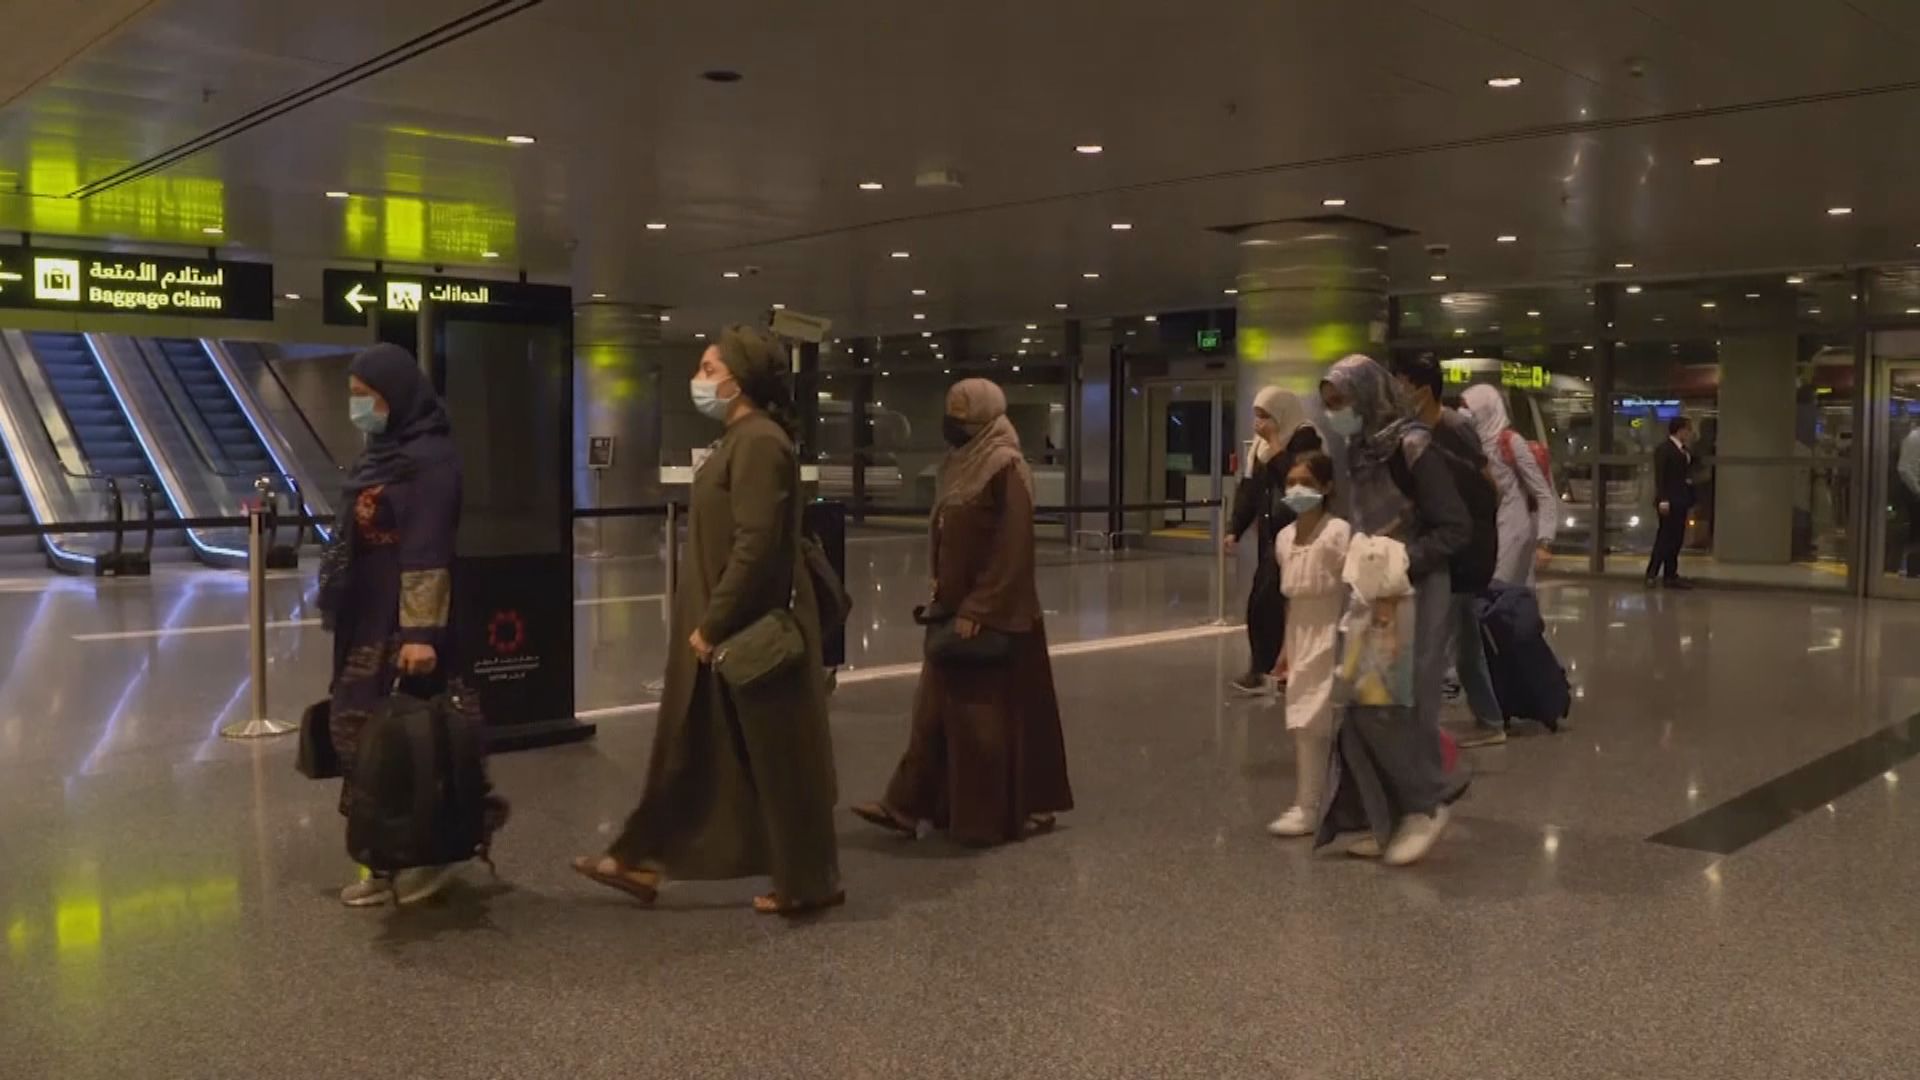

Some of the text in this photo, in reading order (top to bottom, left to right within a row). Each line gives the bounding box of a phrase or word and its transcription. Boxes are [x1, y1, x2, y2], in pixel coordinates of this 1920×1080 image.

[89, 261, 223, 289] استلام الأمتعة
[89, 286, 222, 309] Baggage Claim
